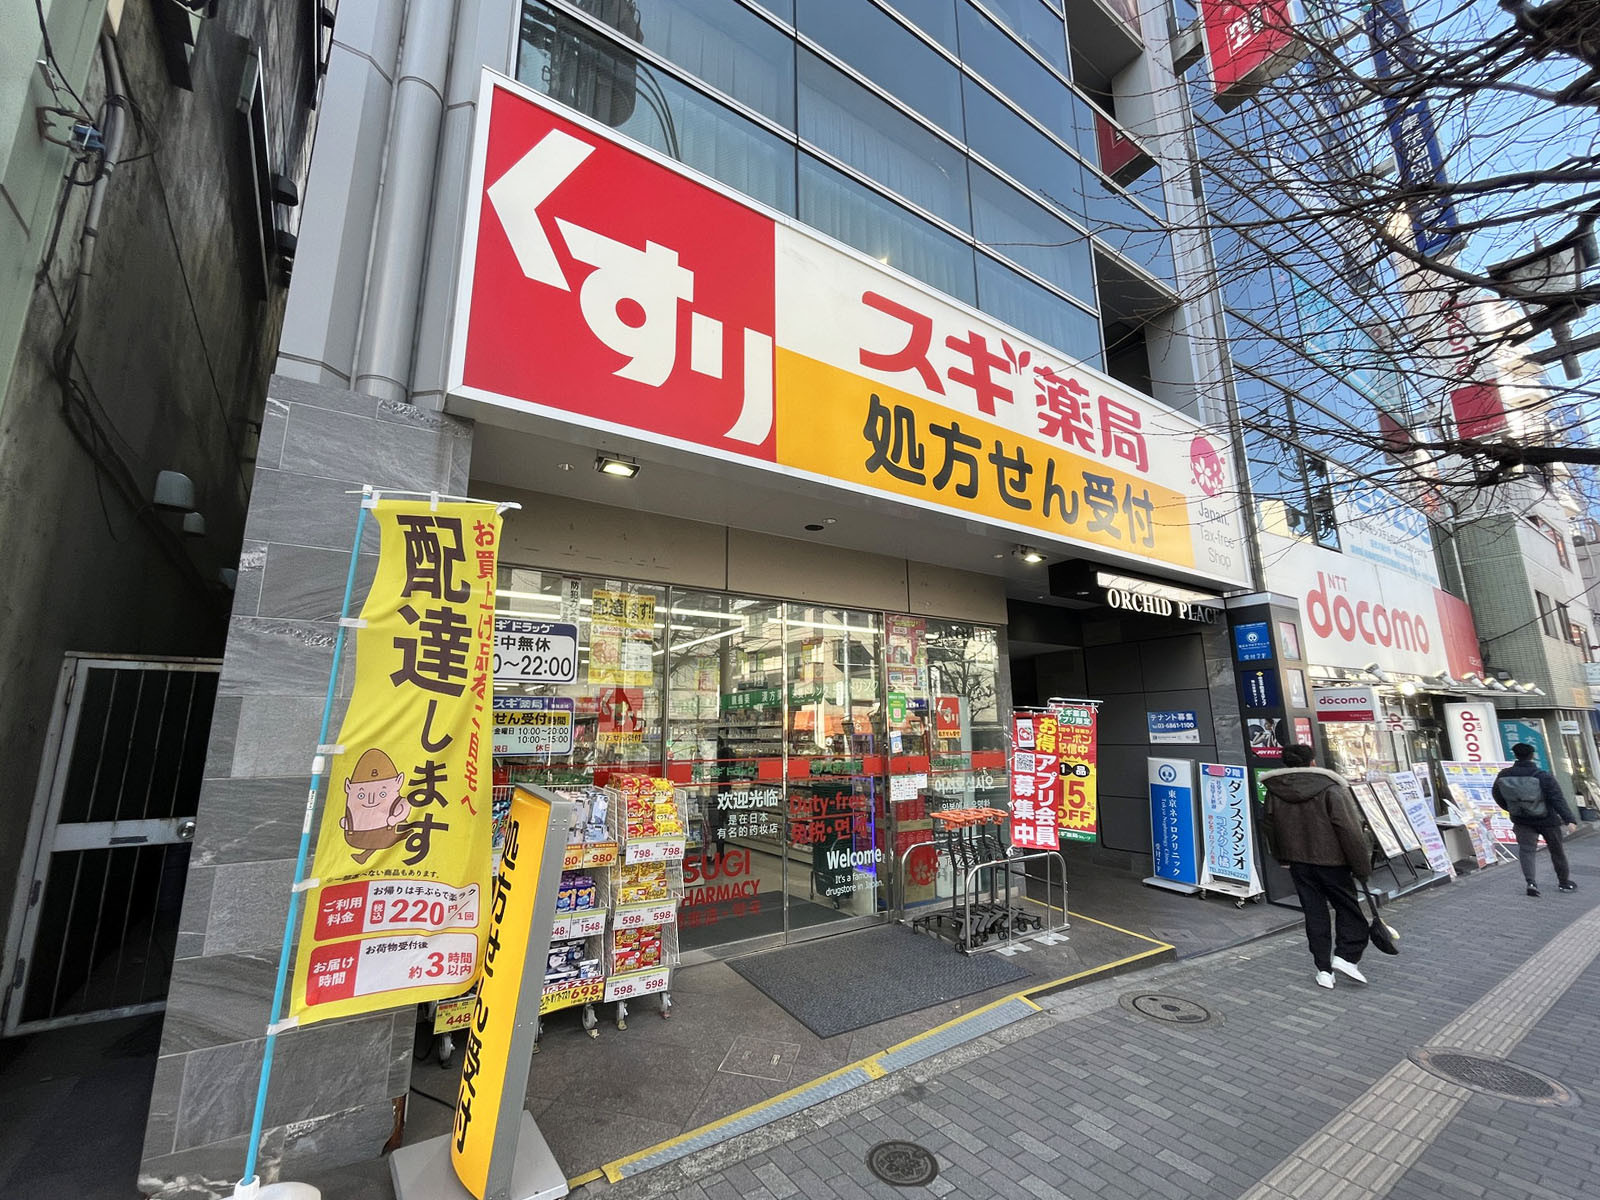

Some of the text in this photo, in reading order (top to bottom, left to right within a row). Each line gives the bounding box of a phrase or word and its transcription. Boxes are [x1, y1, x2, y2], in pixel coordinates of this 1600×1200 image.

[487, 128, 773, 446] くすり
[859, 291, 1150, 473] スギ薬局
[863, 394, 1154, 548] 処方せん受付
[1200, 524, 1235, 549] Tax-free
[1208, 547, 1231, 569] Shop
[1327, 573, 1348, 592] NTT
[1107, 588, 1221, 624] ORCHID PLACE
[1306, 571, 1430, 654] docomo
[495, 620, 555, 633] ギドラッグ
[390, 514, 472, 866] 配達します
[1319, 694, 1367, 706] docomo
[717, 790, 778, 811] 欢迎光临
[789, 792, 866, 817] Duty-free
[1014, 775, 1036, 845] 募集中
[728, 812, 768, 825] 是在日本
[1229, 780, 1246, 870] ダンススタジオ
[1168, 789, 1181, 876] 東京ネフロクリニック
[592, 854, 612, 862] 980
[634, 848, 680, 859] 798 798
[827, 848, 882, 870] Welcome
[683, 848, 750, 883] SUGI
[681, 879, 761, 908] HARMACY
[825, 884, 857, 897] drugstore
[323, 897, 363, 912] ご利用
[389, 899, 445, 925] 220
[327, 911, 354, 926] 料金
[580, 922, 600, 932] 1548
[622, 911, 671, 925] 598 598
[365, 941, 428, 955] お荷物受付後
[313, 956, 354, 974] お届け
[425, 952, 445, 978] 3
[447, 952, 472, 964] 時間
[447, 964, 472, 976] 以内
[318, 972, 346, 987] 時間
[613, 979, 664, 996] 598 598
[571, 985, 599, 999] 698
[446, 1013, 471, 1025] 448
